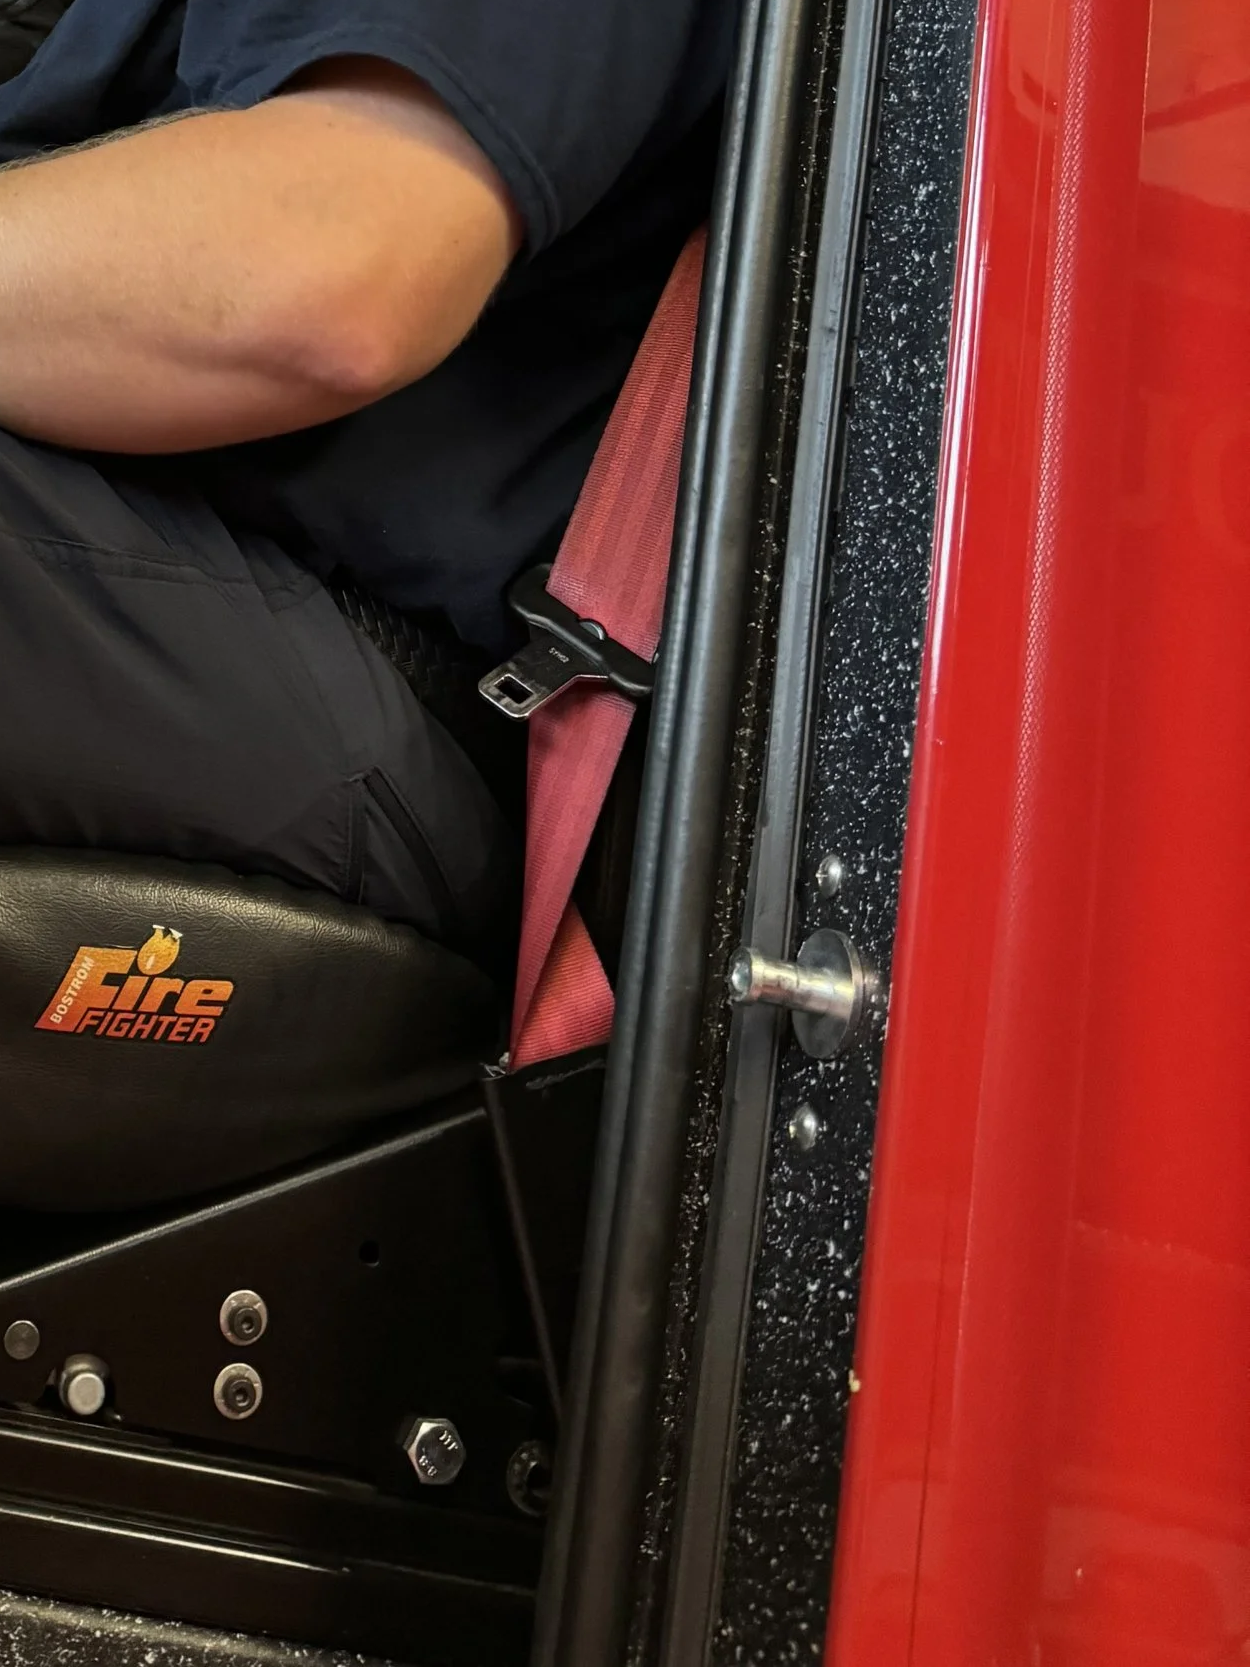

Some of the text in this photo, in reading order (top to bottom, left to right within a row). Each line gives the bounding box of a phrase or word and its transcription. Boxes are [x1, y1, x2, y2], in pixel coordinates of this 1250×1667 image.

[34, 925, 234, 1032] Fire
[49, 955, 95, 1024] BOSTROM
[75, 1009, 216, 1043] FIGHTER
